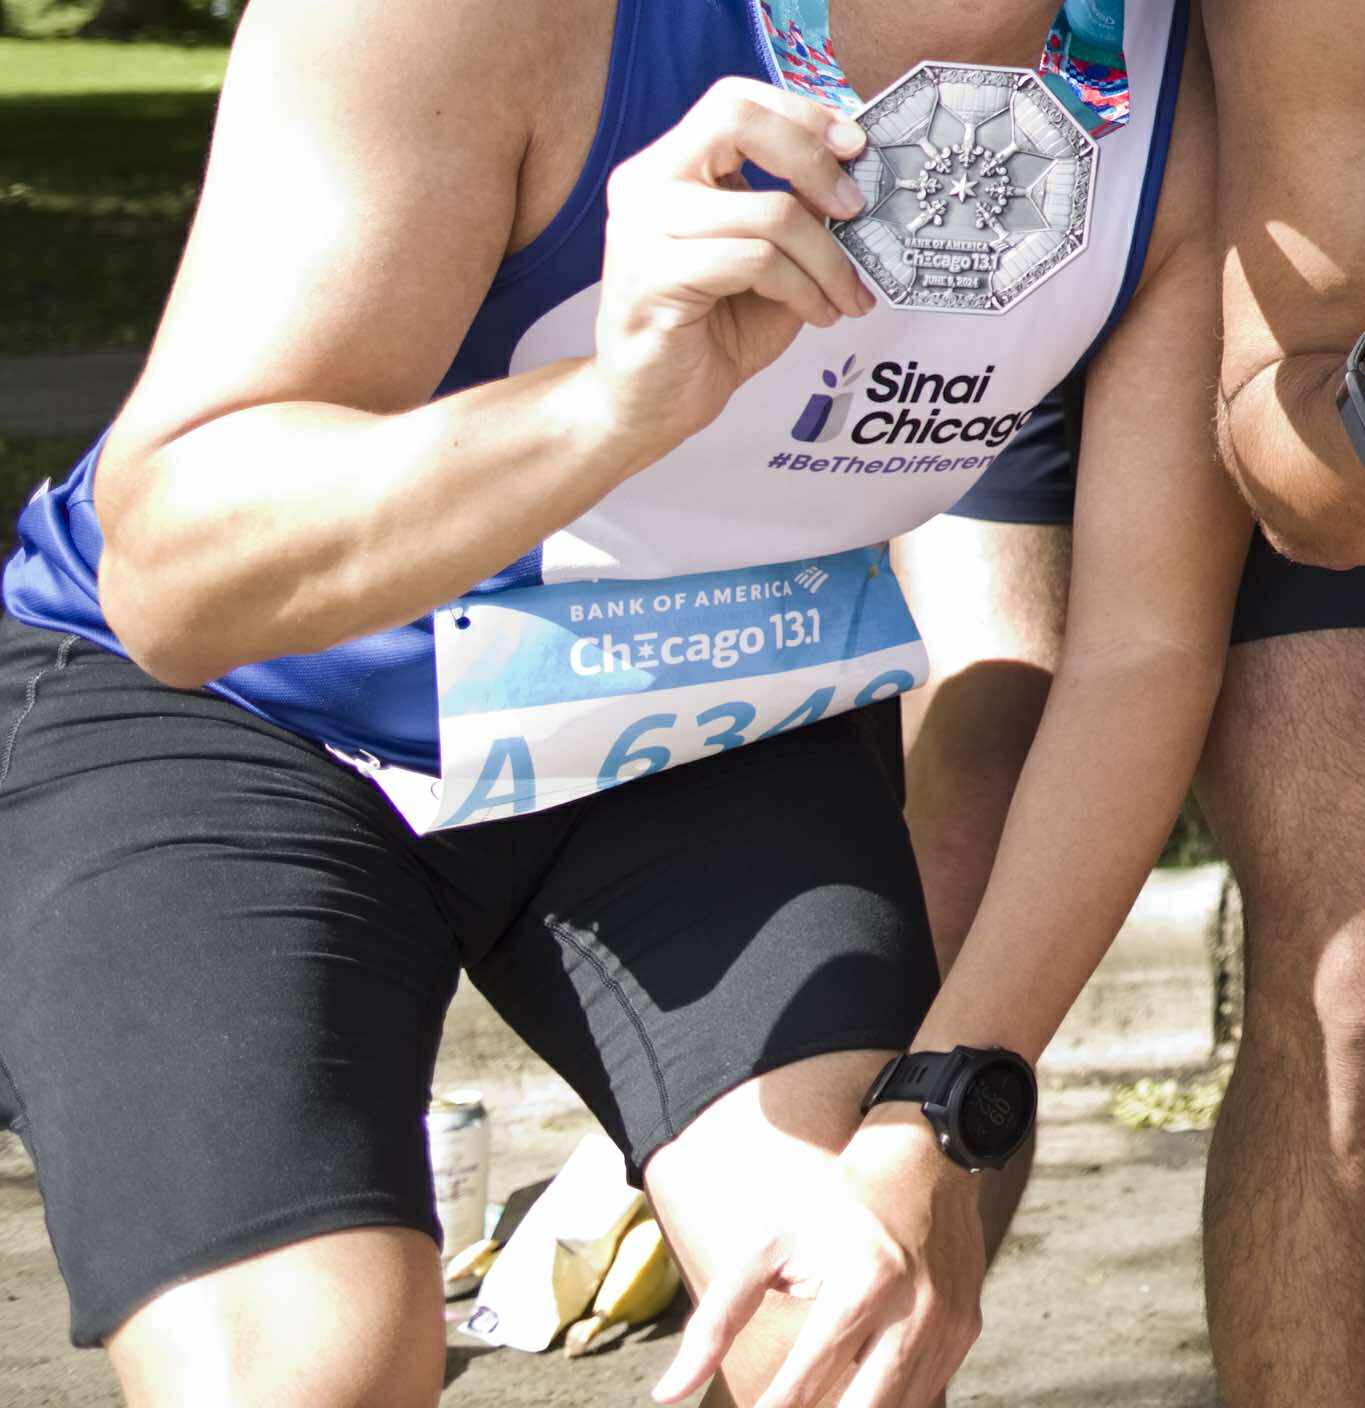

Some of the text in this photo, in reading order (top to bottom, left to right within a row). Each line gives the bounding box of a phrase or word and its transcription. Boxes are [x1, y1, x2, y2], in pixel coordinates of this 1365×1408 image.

[902, 248, 999, 273] Chicago 13.1
[866, 361, 995, 404] Sinai
[768, 453, 1000, 474] #BeTheDifferen
[570, 581, 793, 623] BANK OF AMERICA
[569, 608, 822, 676] Chicago 13.1
[440, 735, 538, 828] A
